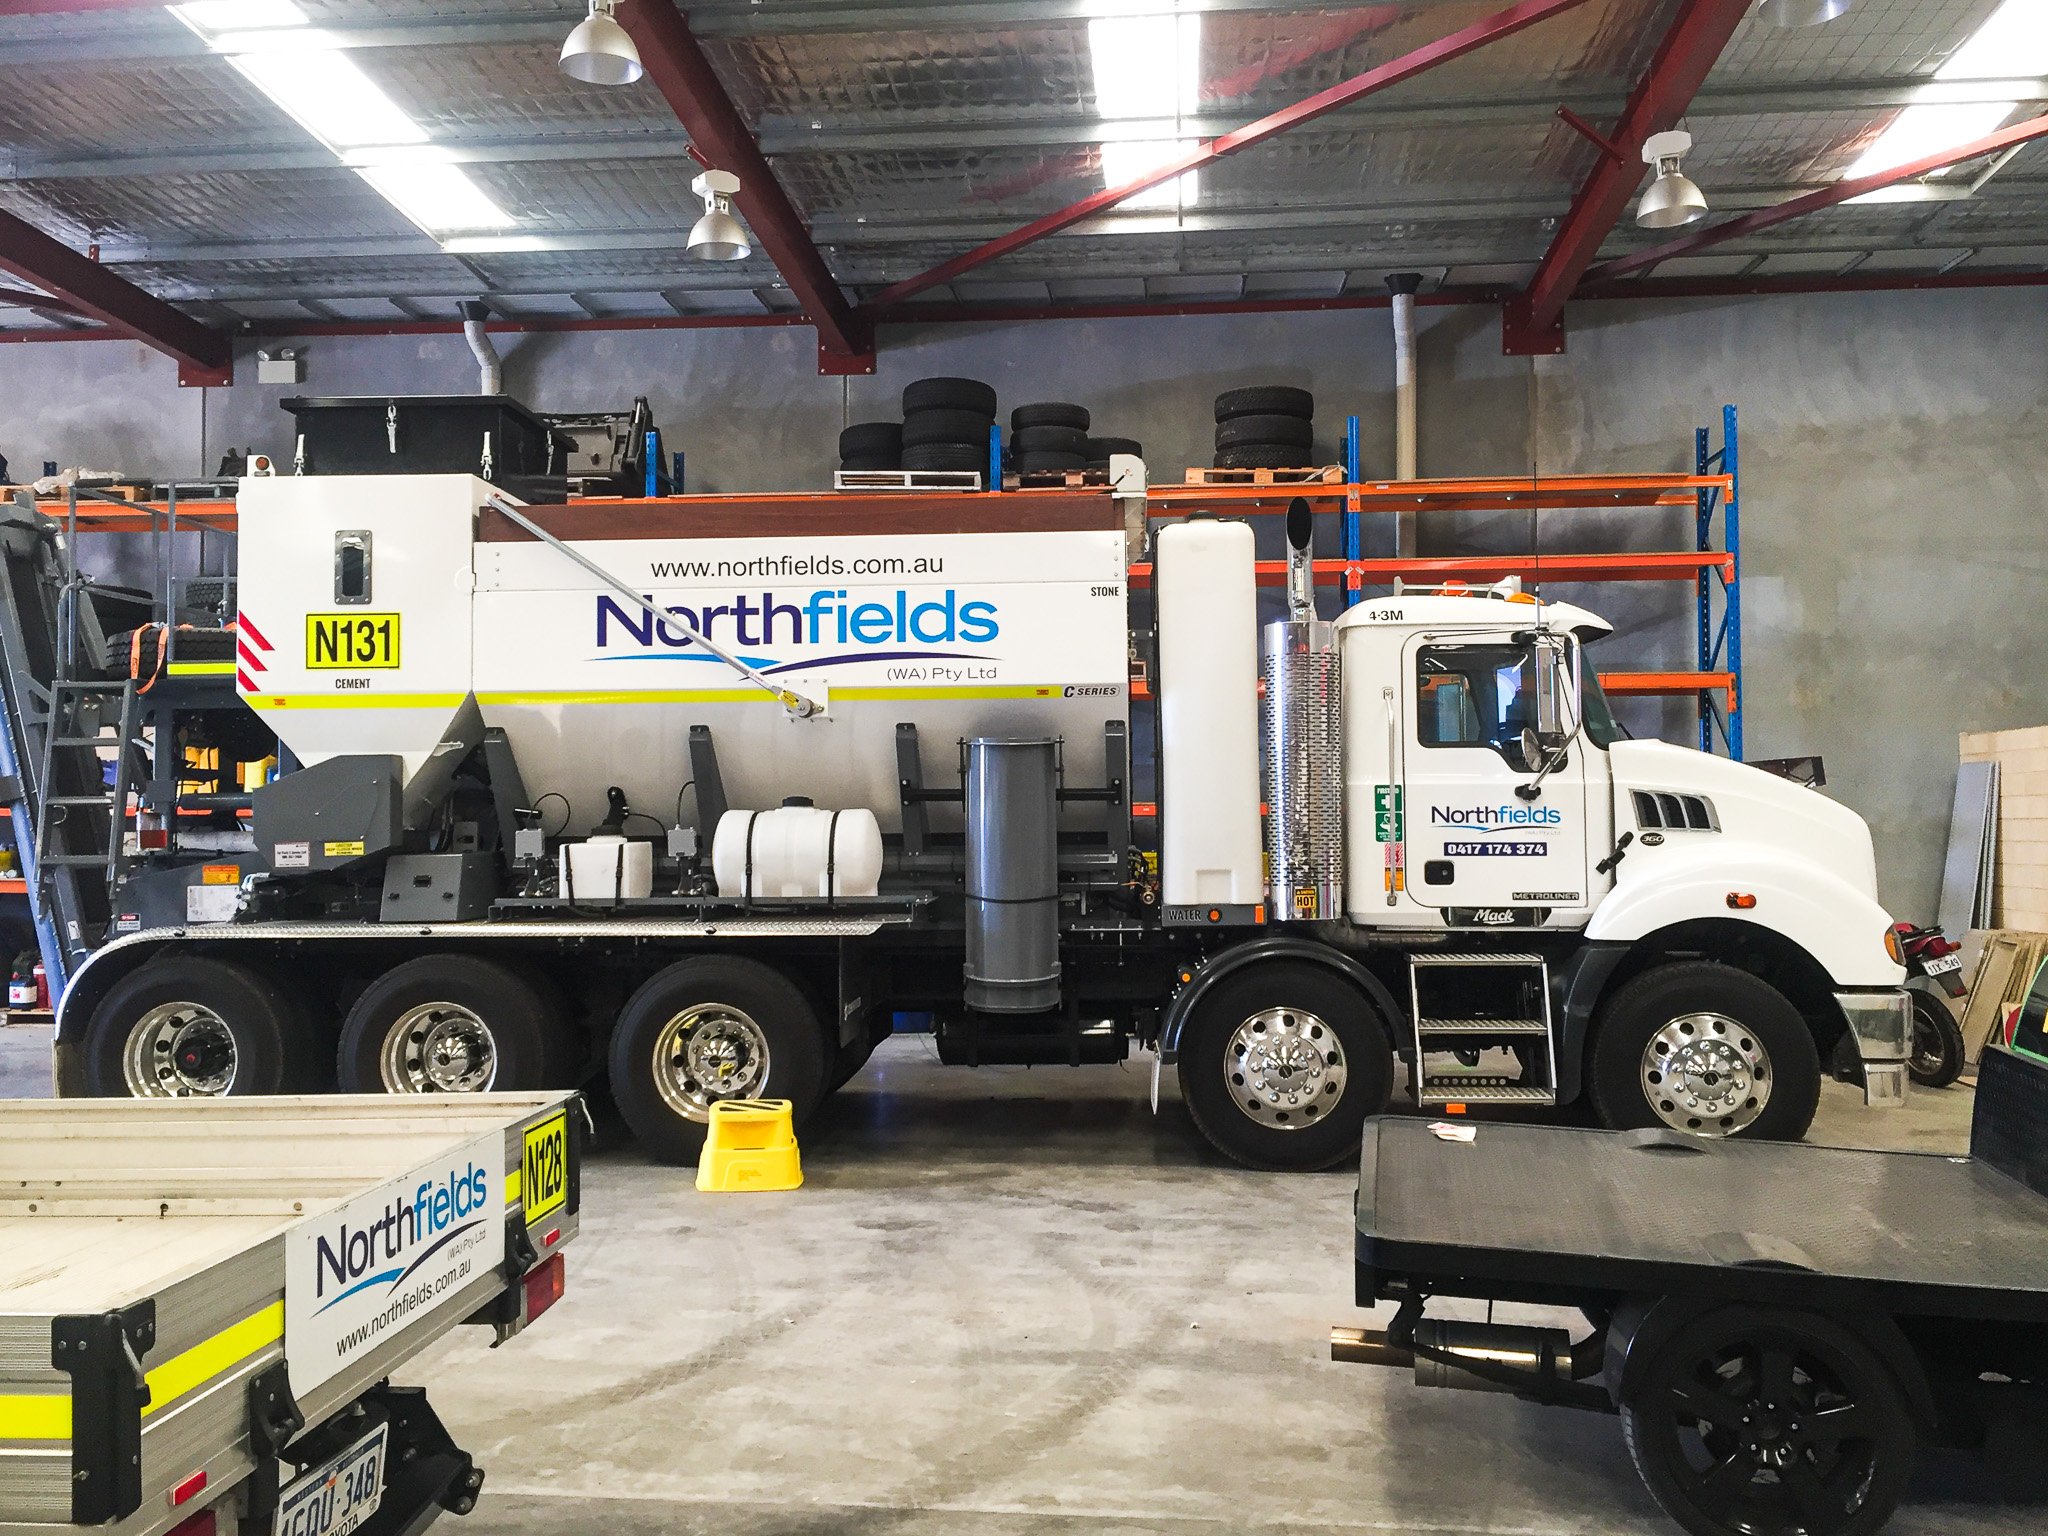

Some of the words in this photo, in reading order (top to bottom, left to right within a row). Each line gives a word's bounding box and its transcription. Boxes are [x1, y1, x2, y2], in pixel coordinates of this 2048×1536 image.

[651, 556, 944, 578] www.northfields.com.au
[1091, 586, 1119, 597] STONE
[597, 589, 999, 648] Northfields
[315, 619, 391, 662] N131
[887, 667, 927, 681] (WA)
[932, 667, 962, 682] Pty
[967, 667, 997, 679] Ltd
[335, 678, 371, 689] CEMENT
[1077, 687, 1117, 696] SERIES
[1431, 805, 1562, 824] Northfields
[1447, 844, 1481, 855] 0417
[1486, 844, 1512, 855] 174
[1516, 844, 1544, 855] 374
[1296, 896, 1315, 907] HOT
[1169, 910, 1201, 921] WATER
[1472, 908, 1515, 925] Mack
[528, 1129, 562, 1210] N128
[316, 1161, 487, 1299] Northfields
[336, 1258, 472, 1357] www.northfields.com.au
